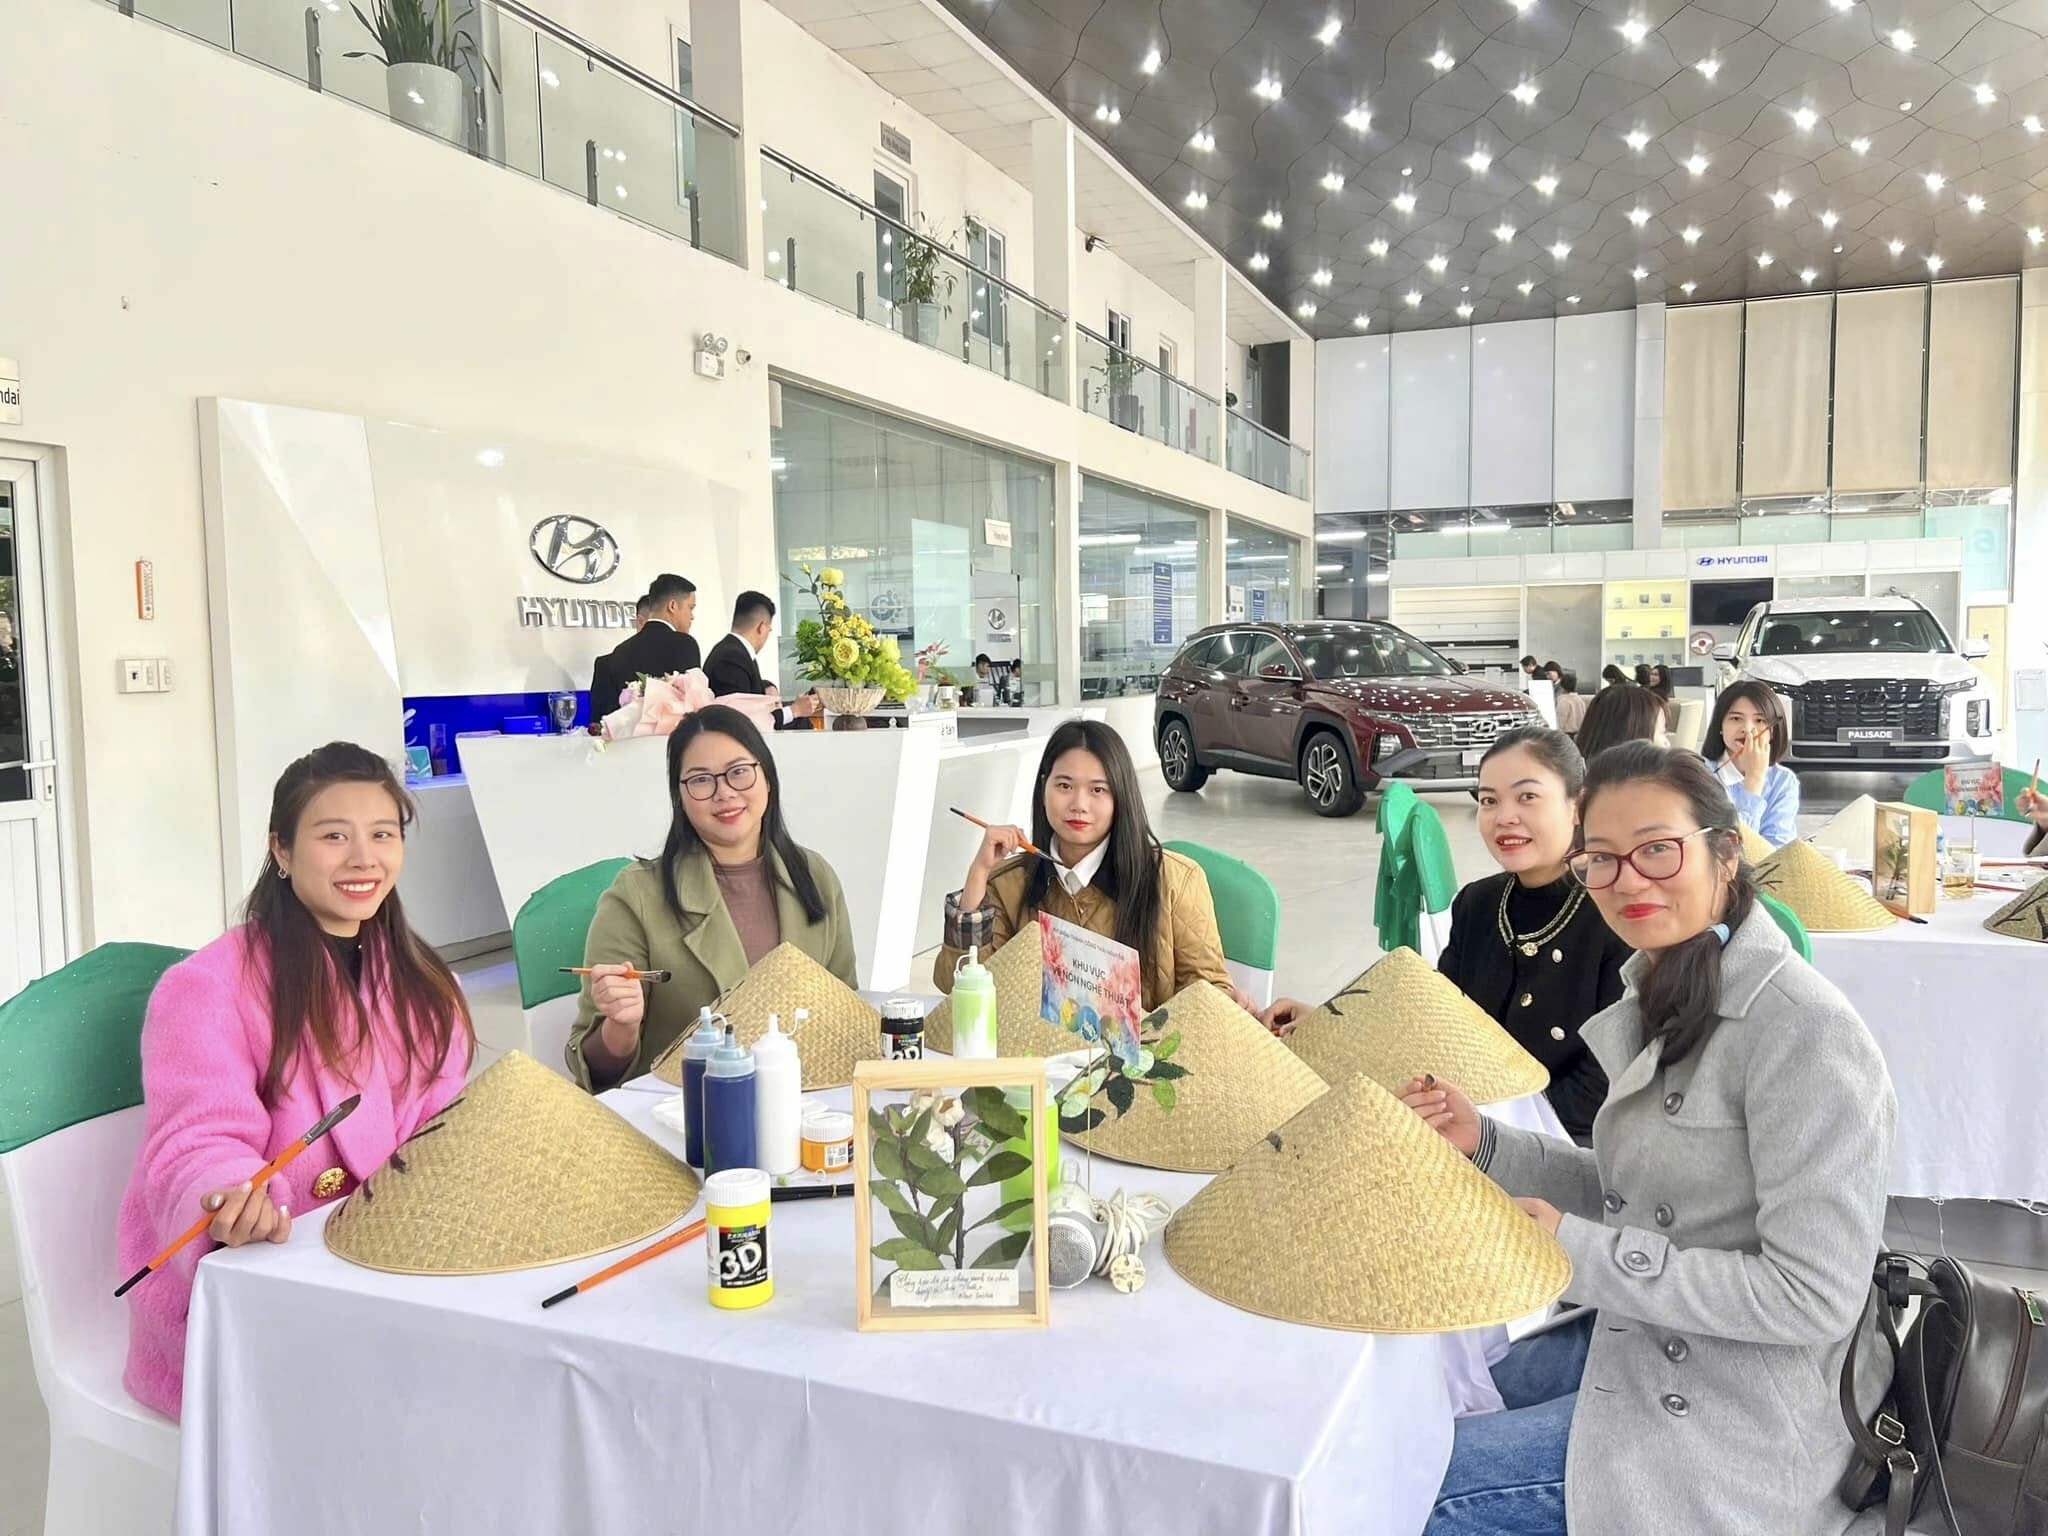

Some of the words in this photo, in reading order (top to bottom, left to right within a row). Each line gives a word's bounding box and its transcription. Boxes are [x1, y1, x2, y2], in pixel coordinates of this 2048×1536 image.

[1717, 555, 1768, 565] HYUNDAI
[516, 596, 638, 628] HYUNDA
[1847, 730, 1893, 739] PALISADE
[1072, 958, 1090, 973] KHU
[719, 1241, 762, 1280] 3D
